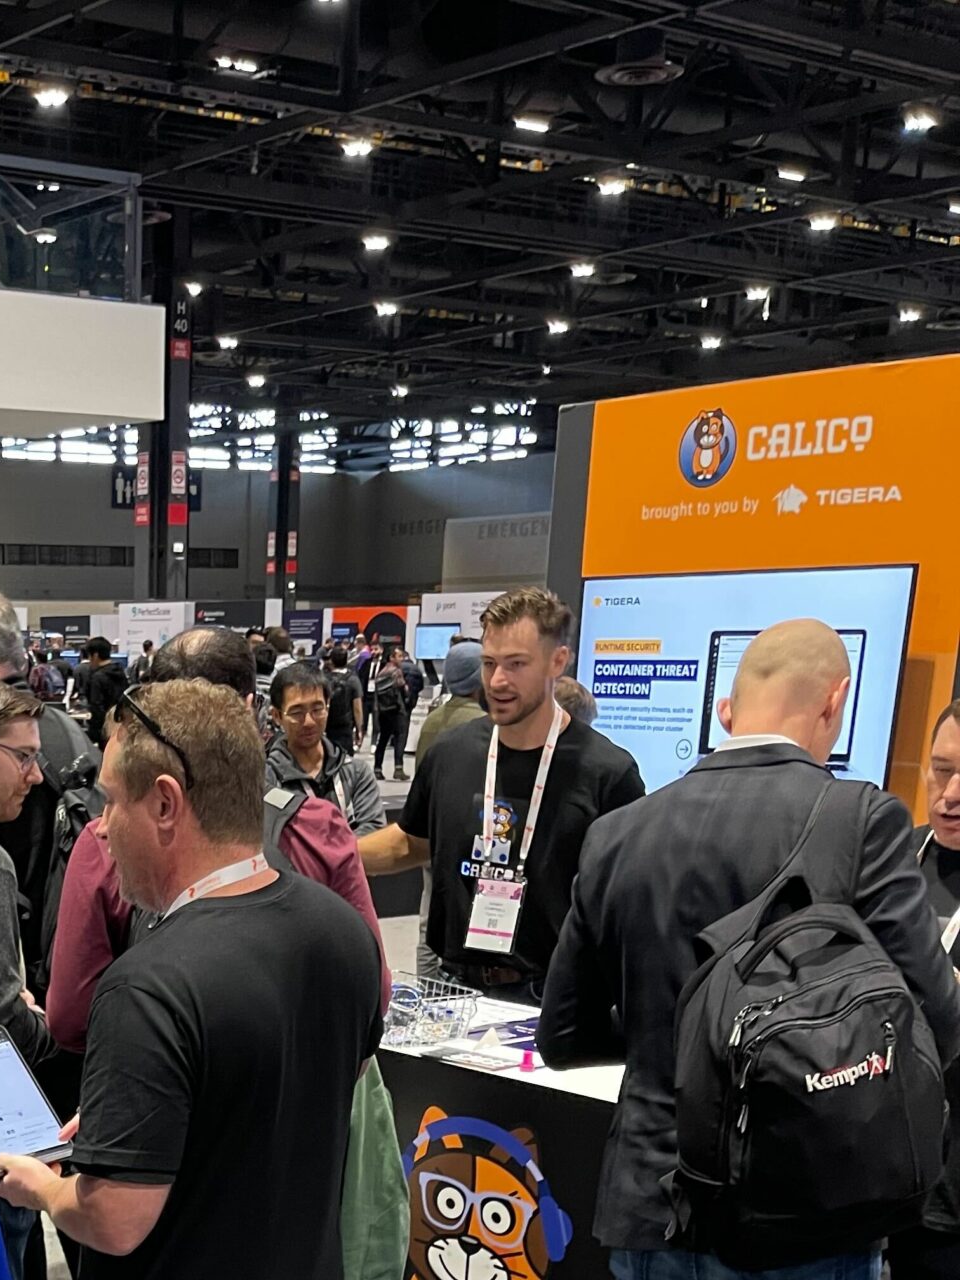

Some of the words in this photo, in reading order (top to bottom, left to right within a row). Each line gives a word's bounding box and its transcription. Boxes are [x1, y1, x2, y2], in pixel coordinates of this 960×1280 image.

[177, 301, 186, 315] H
[174, 319, 189, 333] 40
[746, 415, 873, 461] CALICO
[641, 502, 693, 522] brought
[697, 501, 710, 516] to
[713, 501, 738, 518] you
[742, 497, 759, 515] by
[816, 485, 902, 506] TIGERA
[604, 597, 641, 606] TIGERA
[595, 643, 625, 651] RUNTIME
[626, 643, 660, 651] SECURITY
[595, 664, 655, 676] CONTAINER
[655, 664, 697, 677] THREAT
[593, 682, 650, 695] DETECTION
[805, 1061, 869, 1092] Kempa
